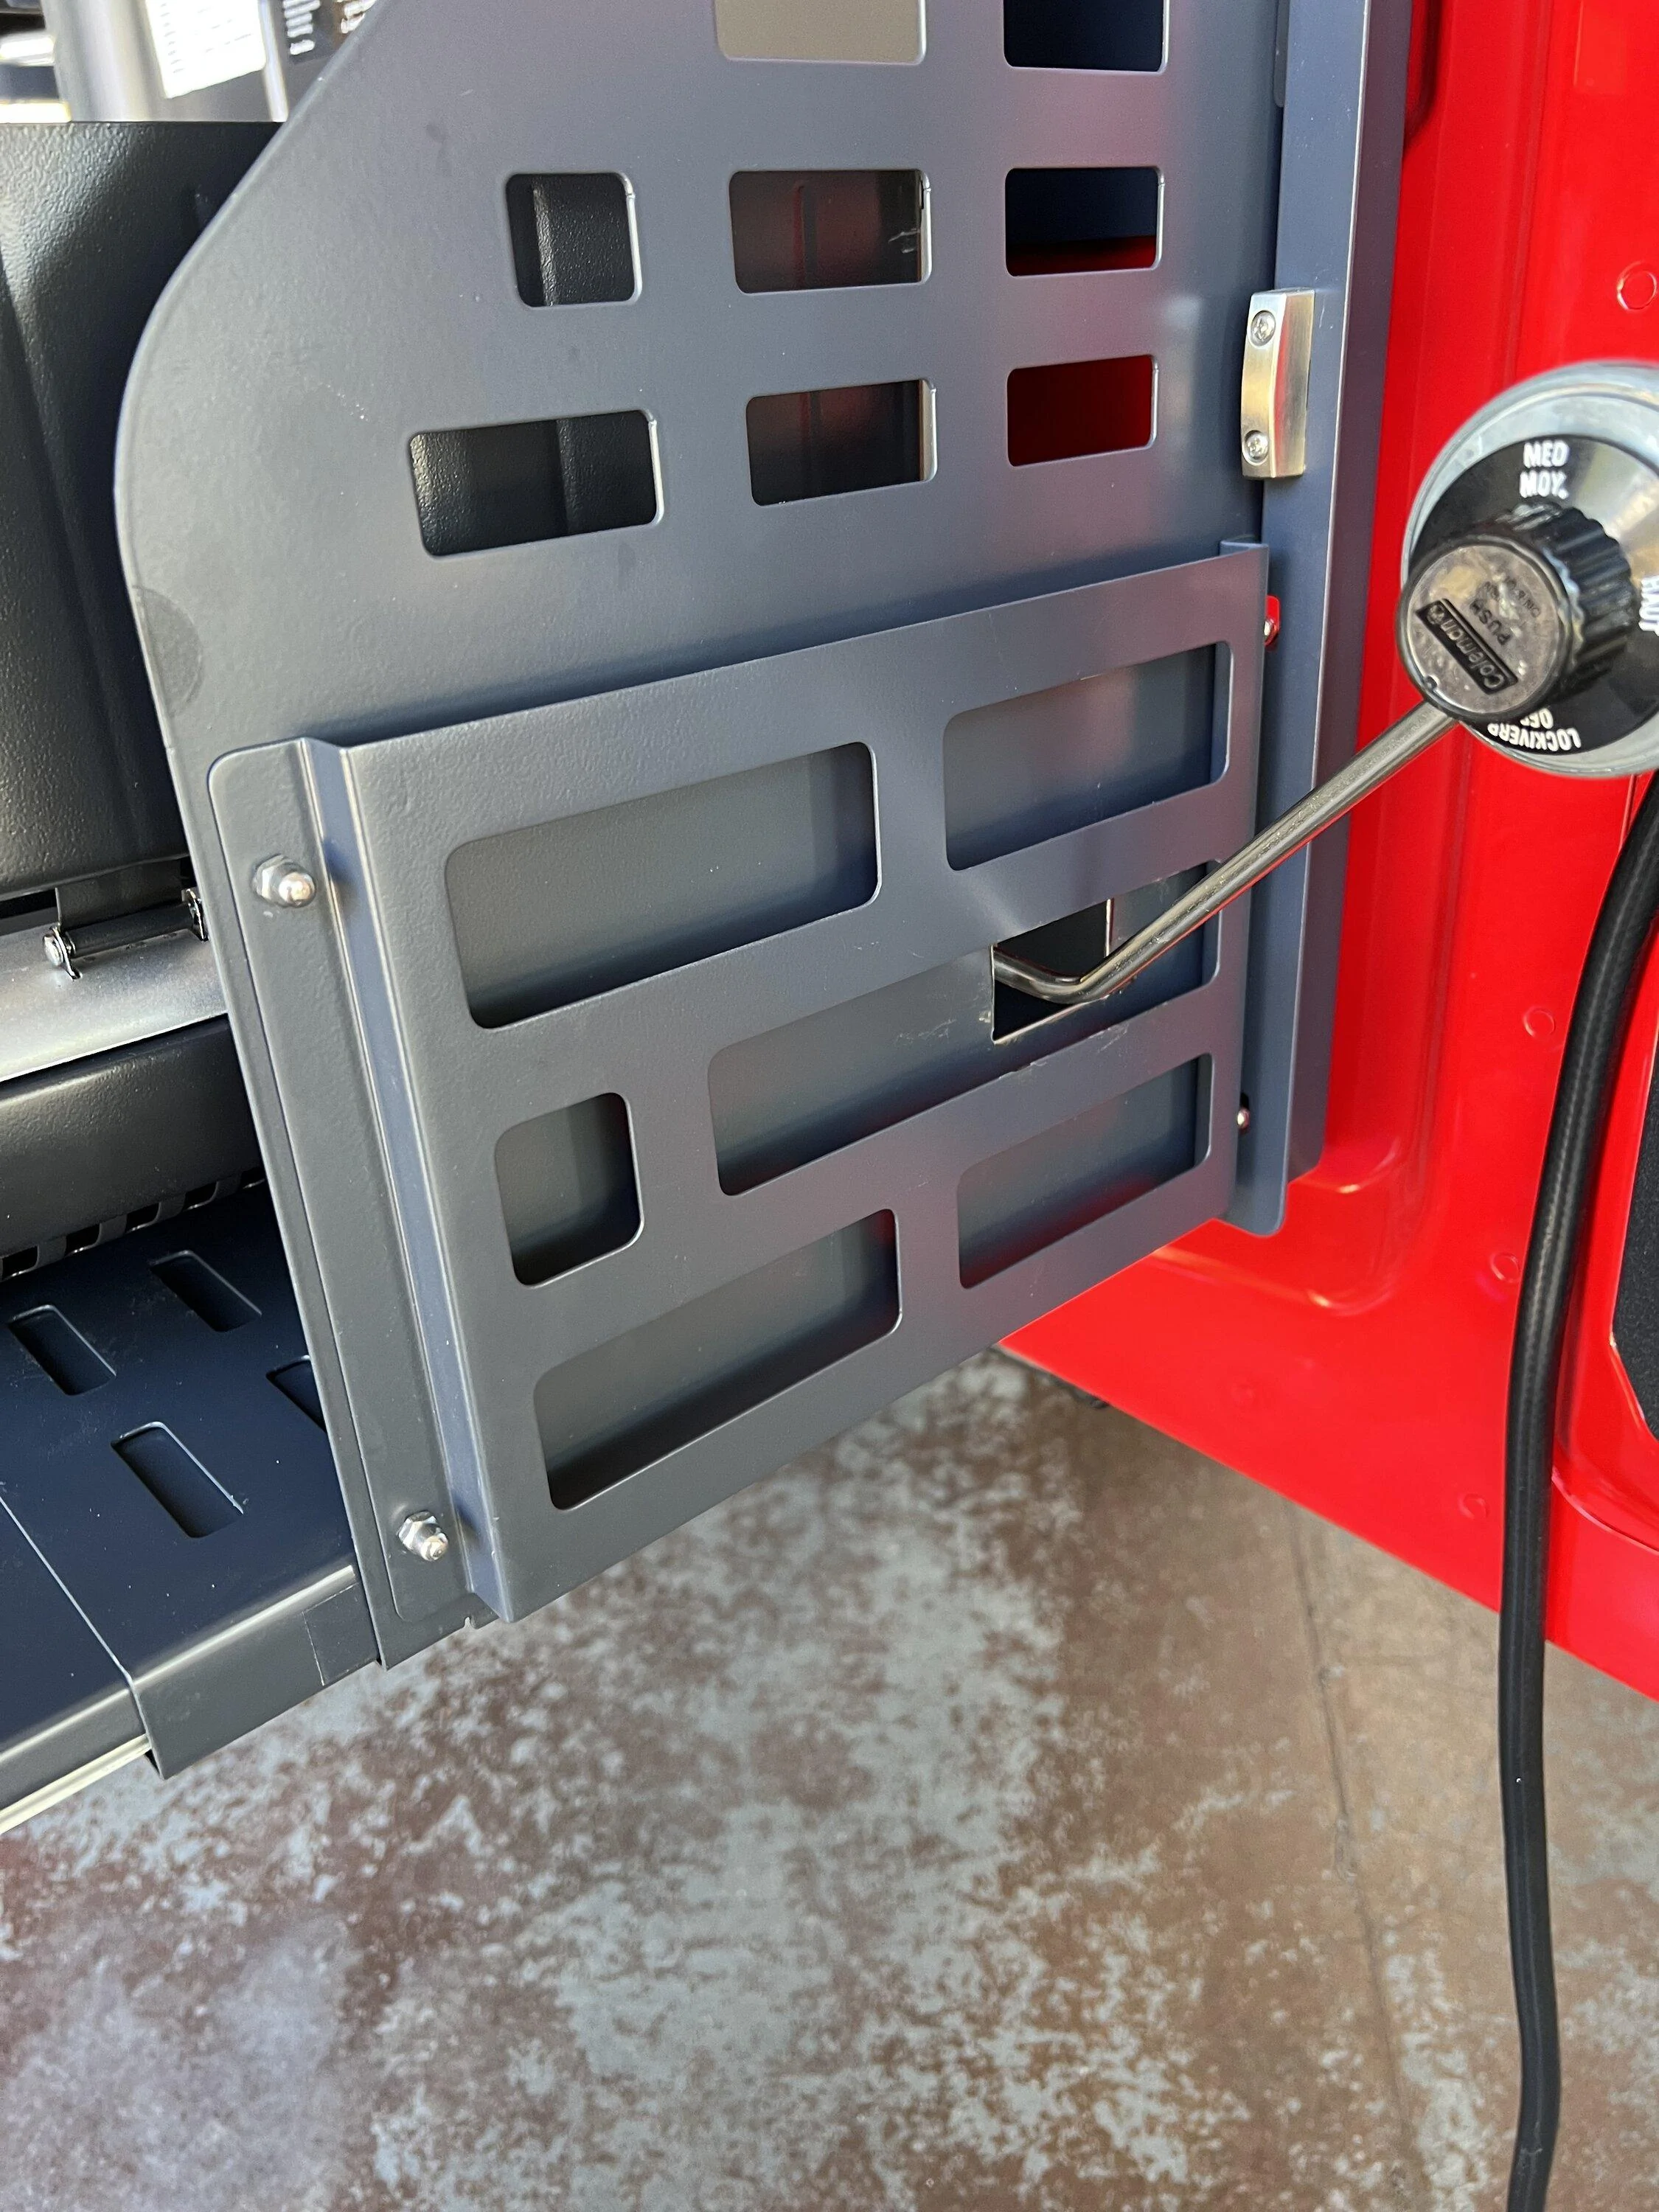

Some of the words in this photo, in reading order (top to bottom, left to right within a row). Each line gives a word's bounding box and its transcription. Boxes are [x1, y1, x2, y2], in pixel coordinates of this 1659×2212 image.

[1523, 439, 1570, 468] MED
[1470, 599, 1512, 646] PUSH
[1440, 618, 1505, 689] Coleman
